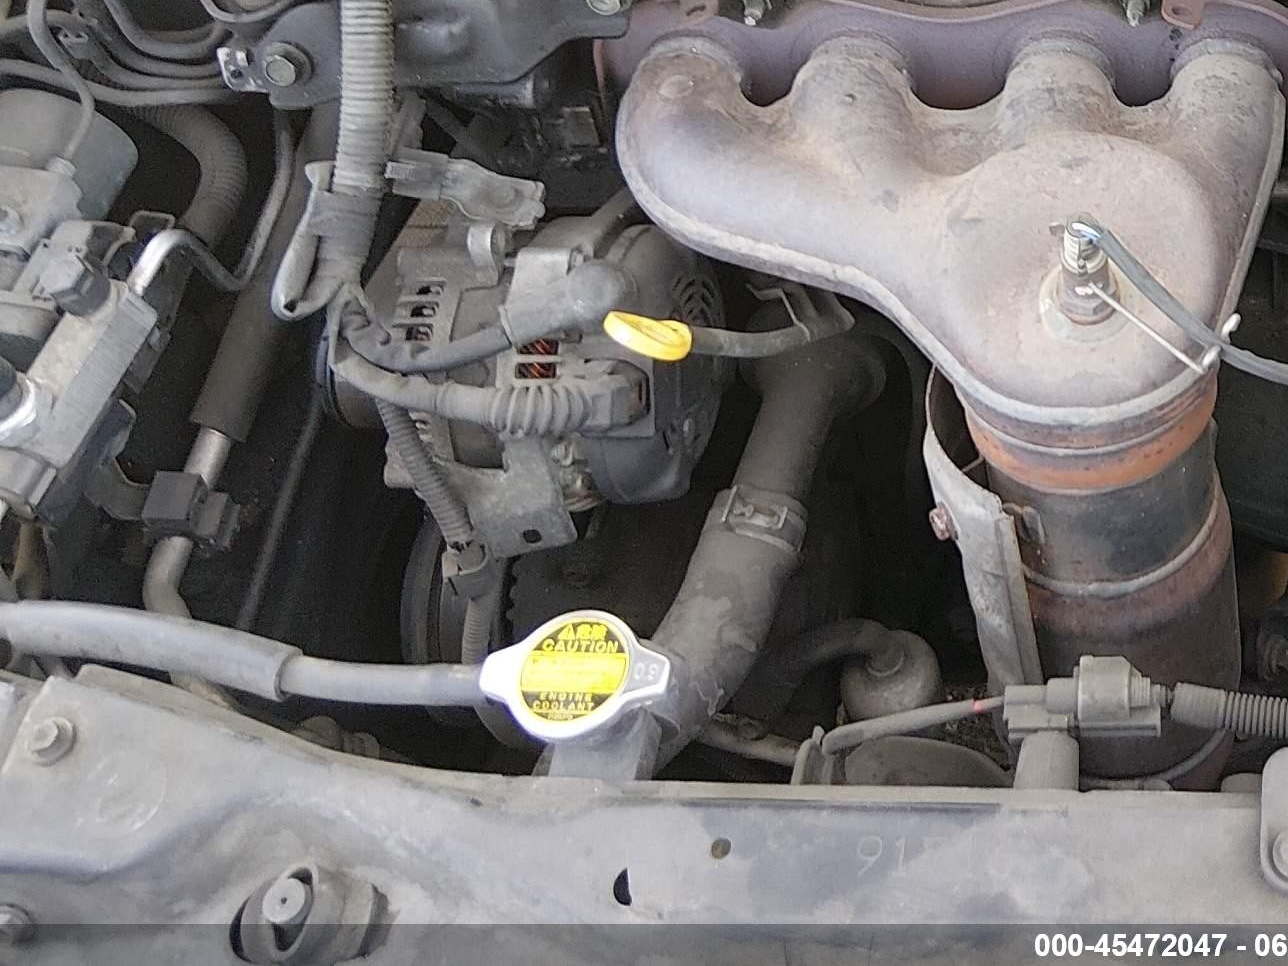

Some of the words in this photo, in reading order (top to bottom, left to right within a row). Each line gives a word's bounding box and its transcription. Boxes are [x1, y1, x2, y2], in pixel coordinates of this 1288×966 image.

[541, 639, 620, 654] CAUTION
[540, 691, 593, 701] ENGINE
[532, 699, 595, 711] COOLANT
